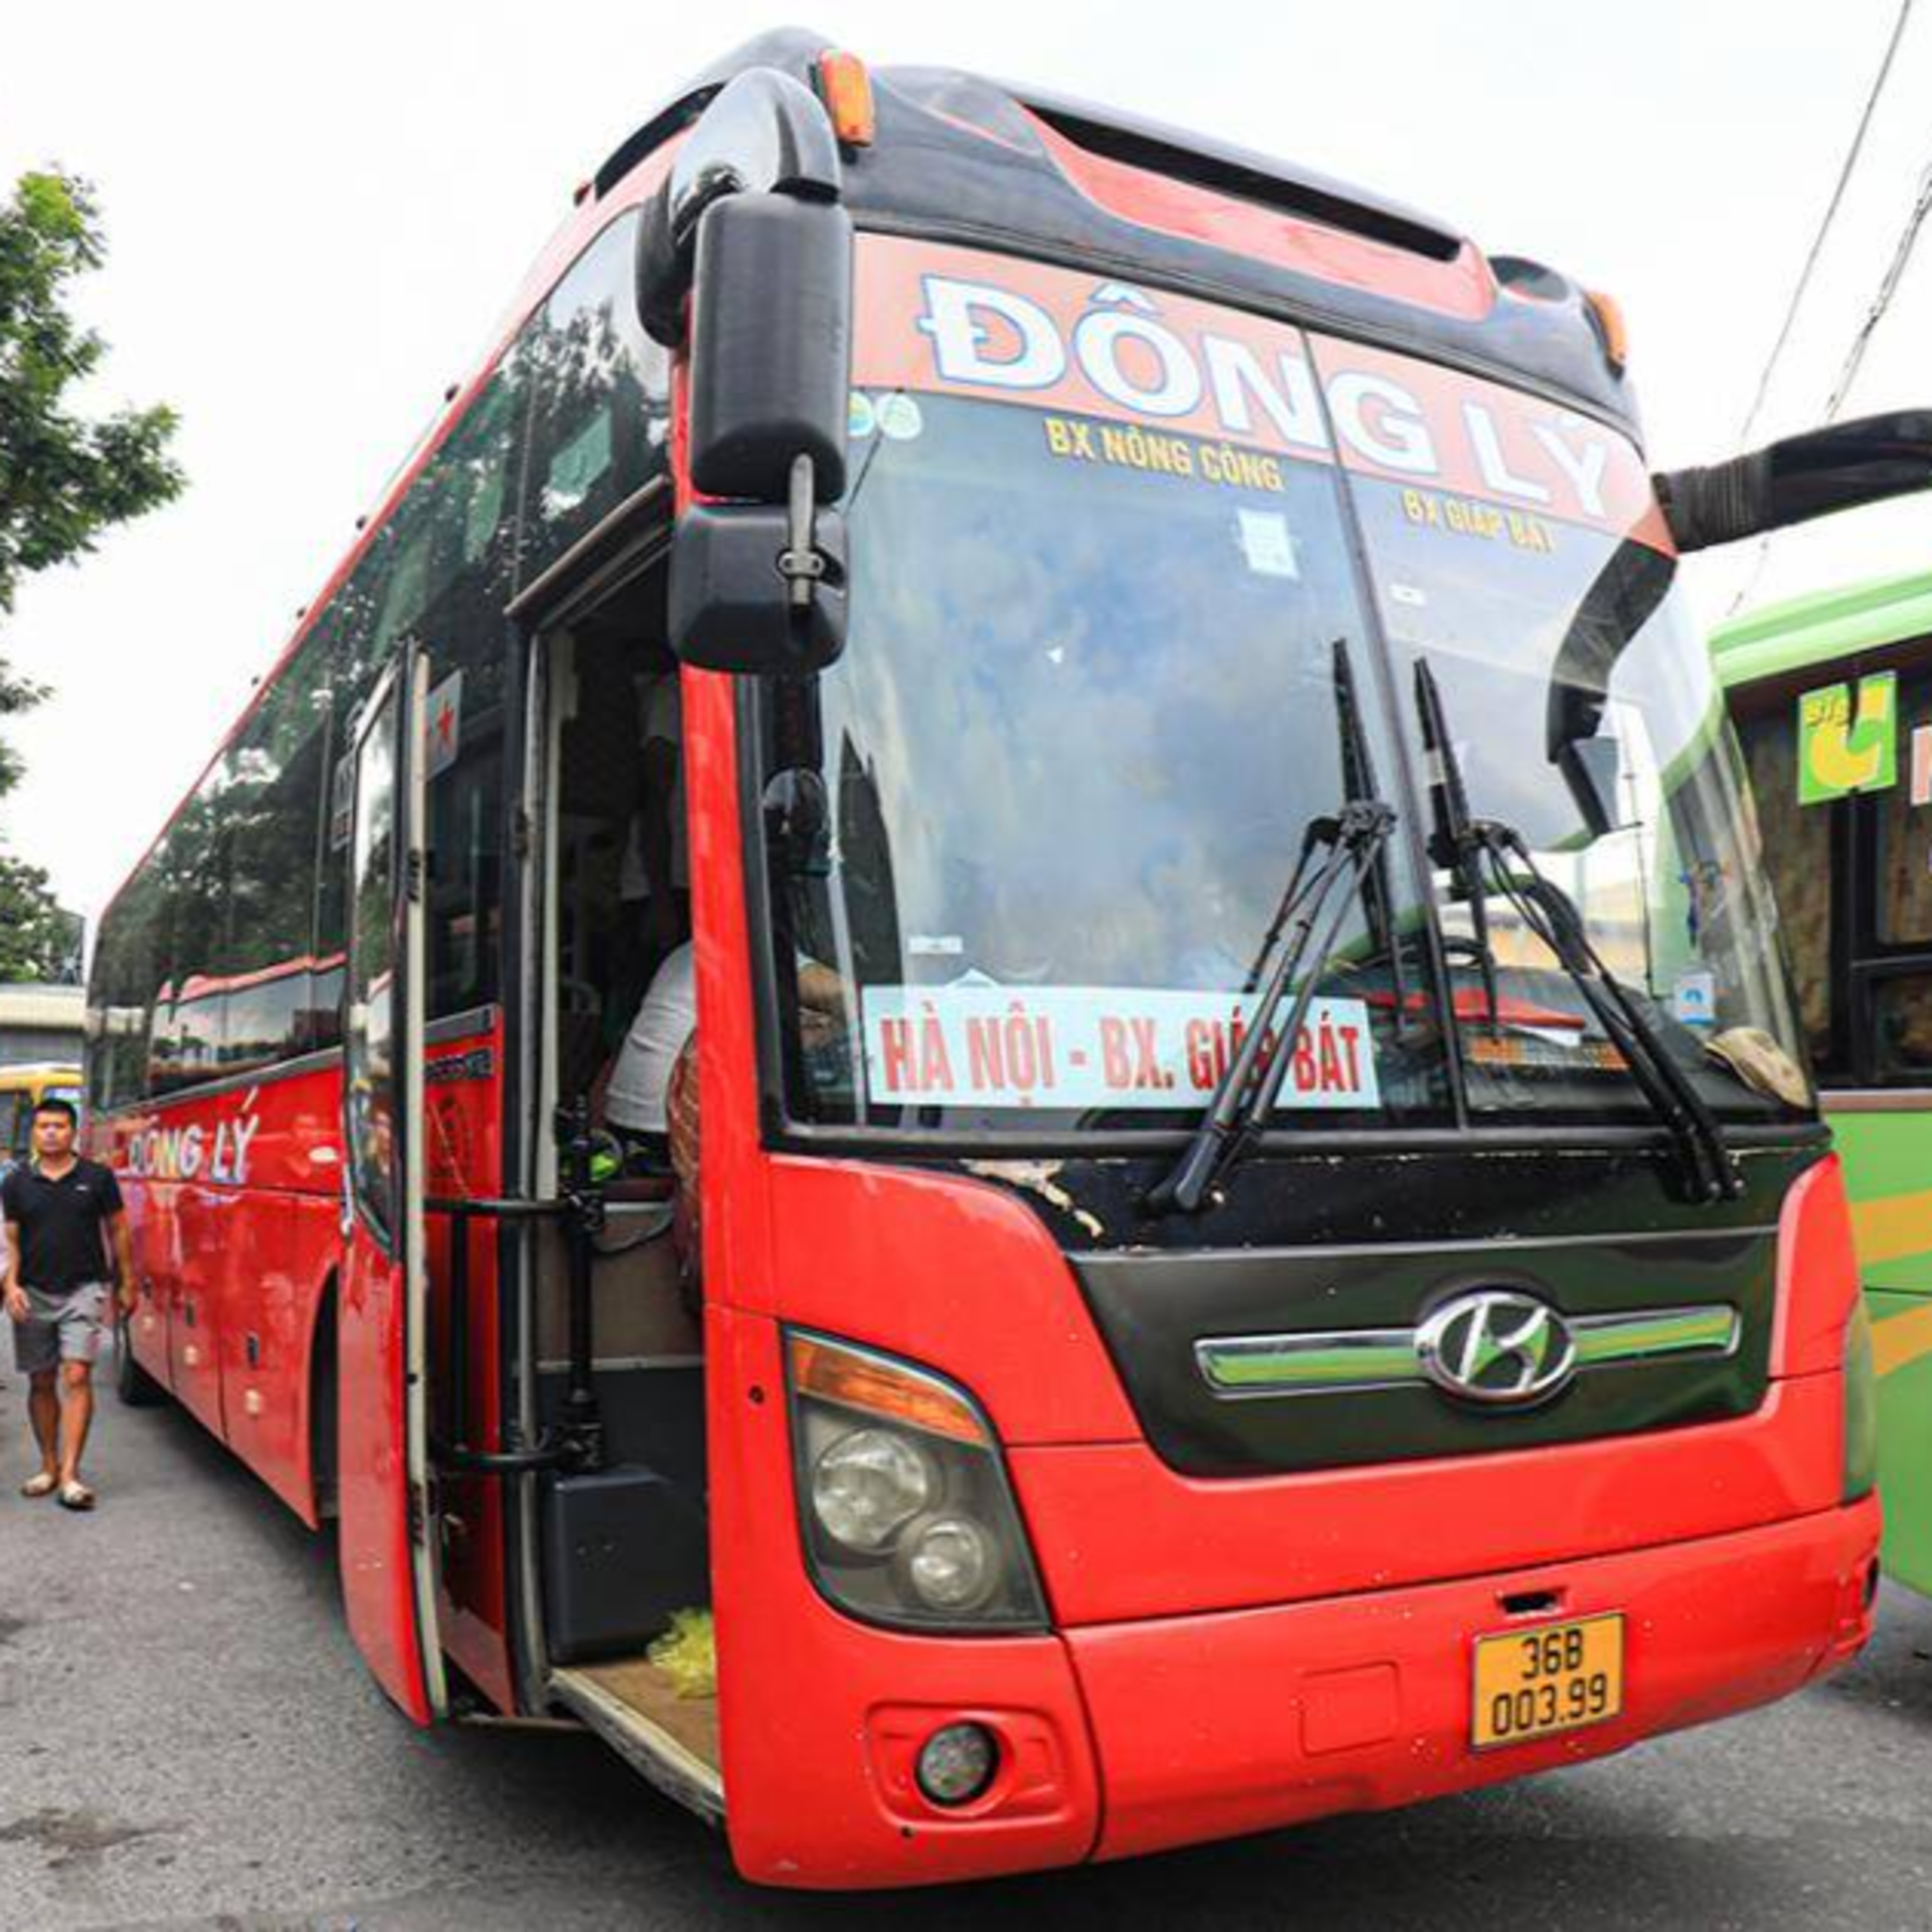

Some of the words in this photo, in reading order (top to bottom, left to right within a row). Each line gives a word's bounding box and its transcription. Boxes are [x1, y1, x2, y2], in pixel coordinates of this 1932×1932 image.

[914, 273, 1440, 475] ĐÔNG
[1462, 399, 1609, 518] LÝ
[1044, 417, 1094, 459] BX
[1099, 425, 1193, 477] NÔNG
[1199, 443, 1285, 492] CÔNG
[880, 1001, 954, 1093] HÀ
[965, 1001, 1056, 1108] NỘI
[1099, 1016, 1174, 1091] BX.
[1293, 1009, 1361, 1092] BÁT
[211, 1085, 259, 1184] LÝ
[1521, 1627, 1584, 1680] 36B
[1492, 1672, 1607, 1736] 003.99
